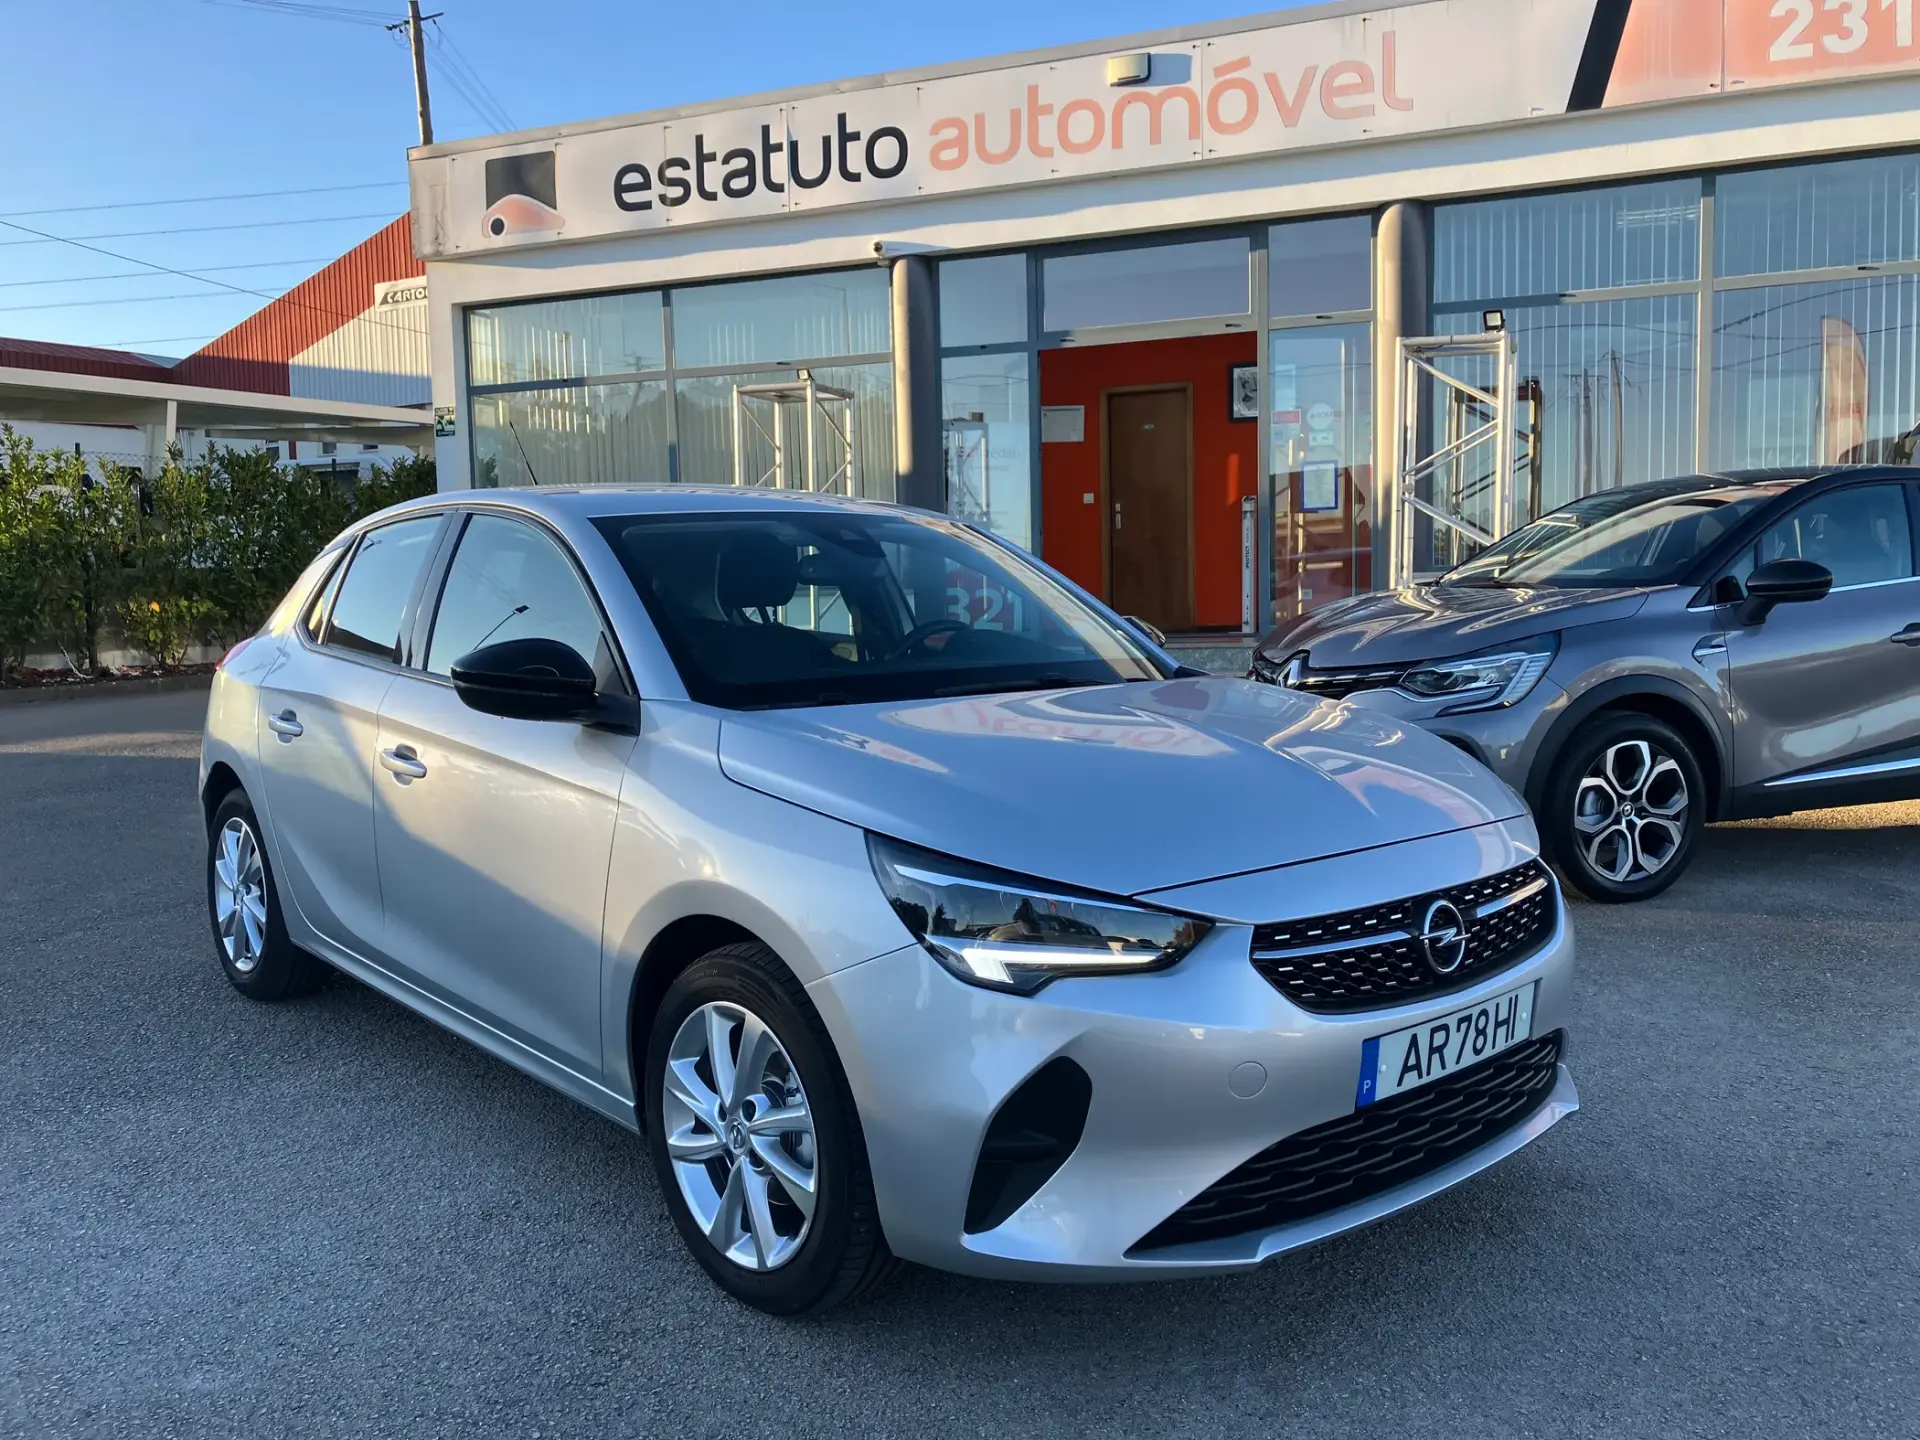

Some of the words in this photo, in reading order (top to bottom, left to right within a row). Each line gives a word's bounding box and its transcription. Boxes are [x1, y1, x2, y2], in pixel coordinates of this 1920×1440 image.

[1769, 0, 1913, 62] 231
[613, 112, 908, 211] estatuto
[928, 30, 1414, 171] automóvel
[1363, 1079, 1371, 1094] P
